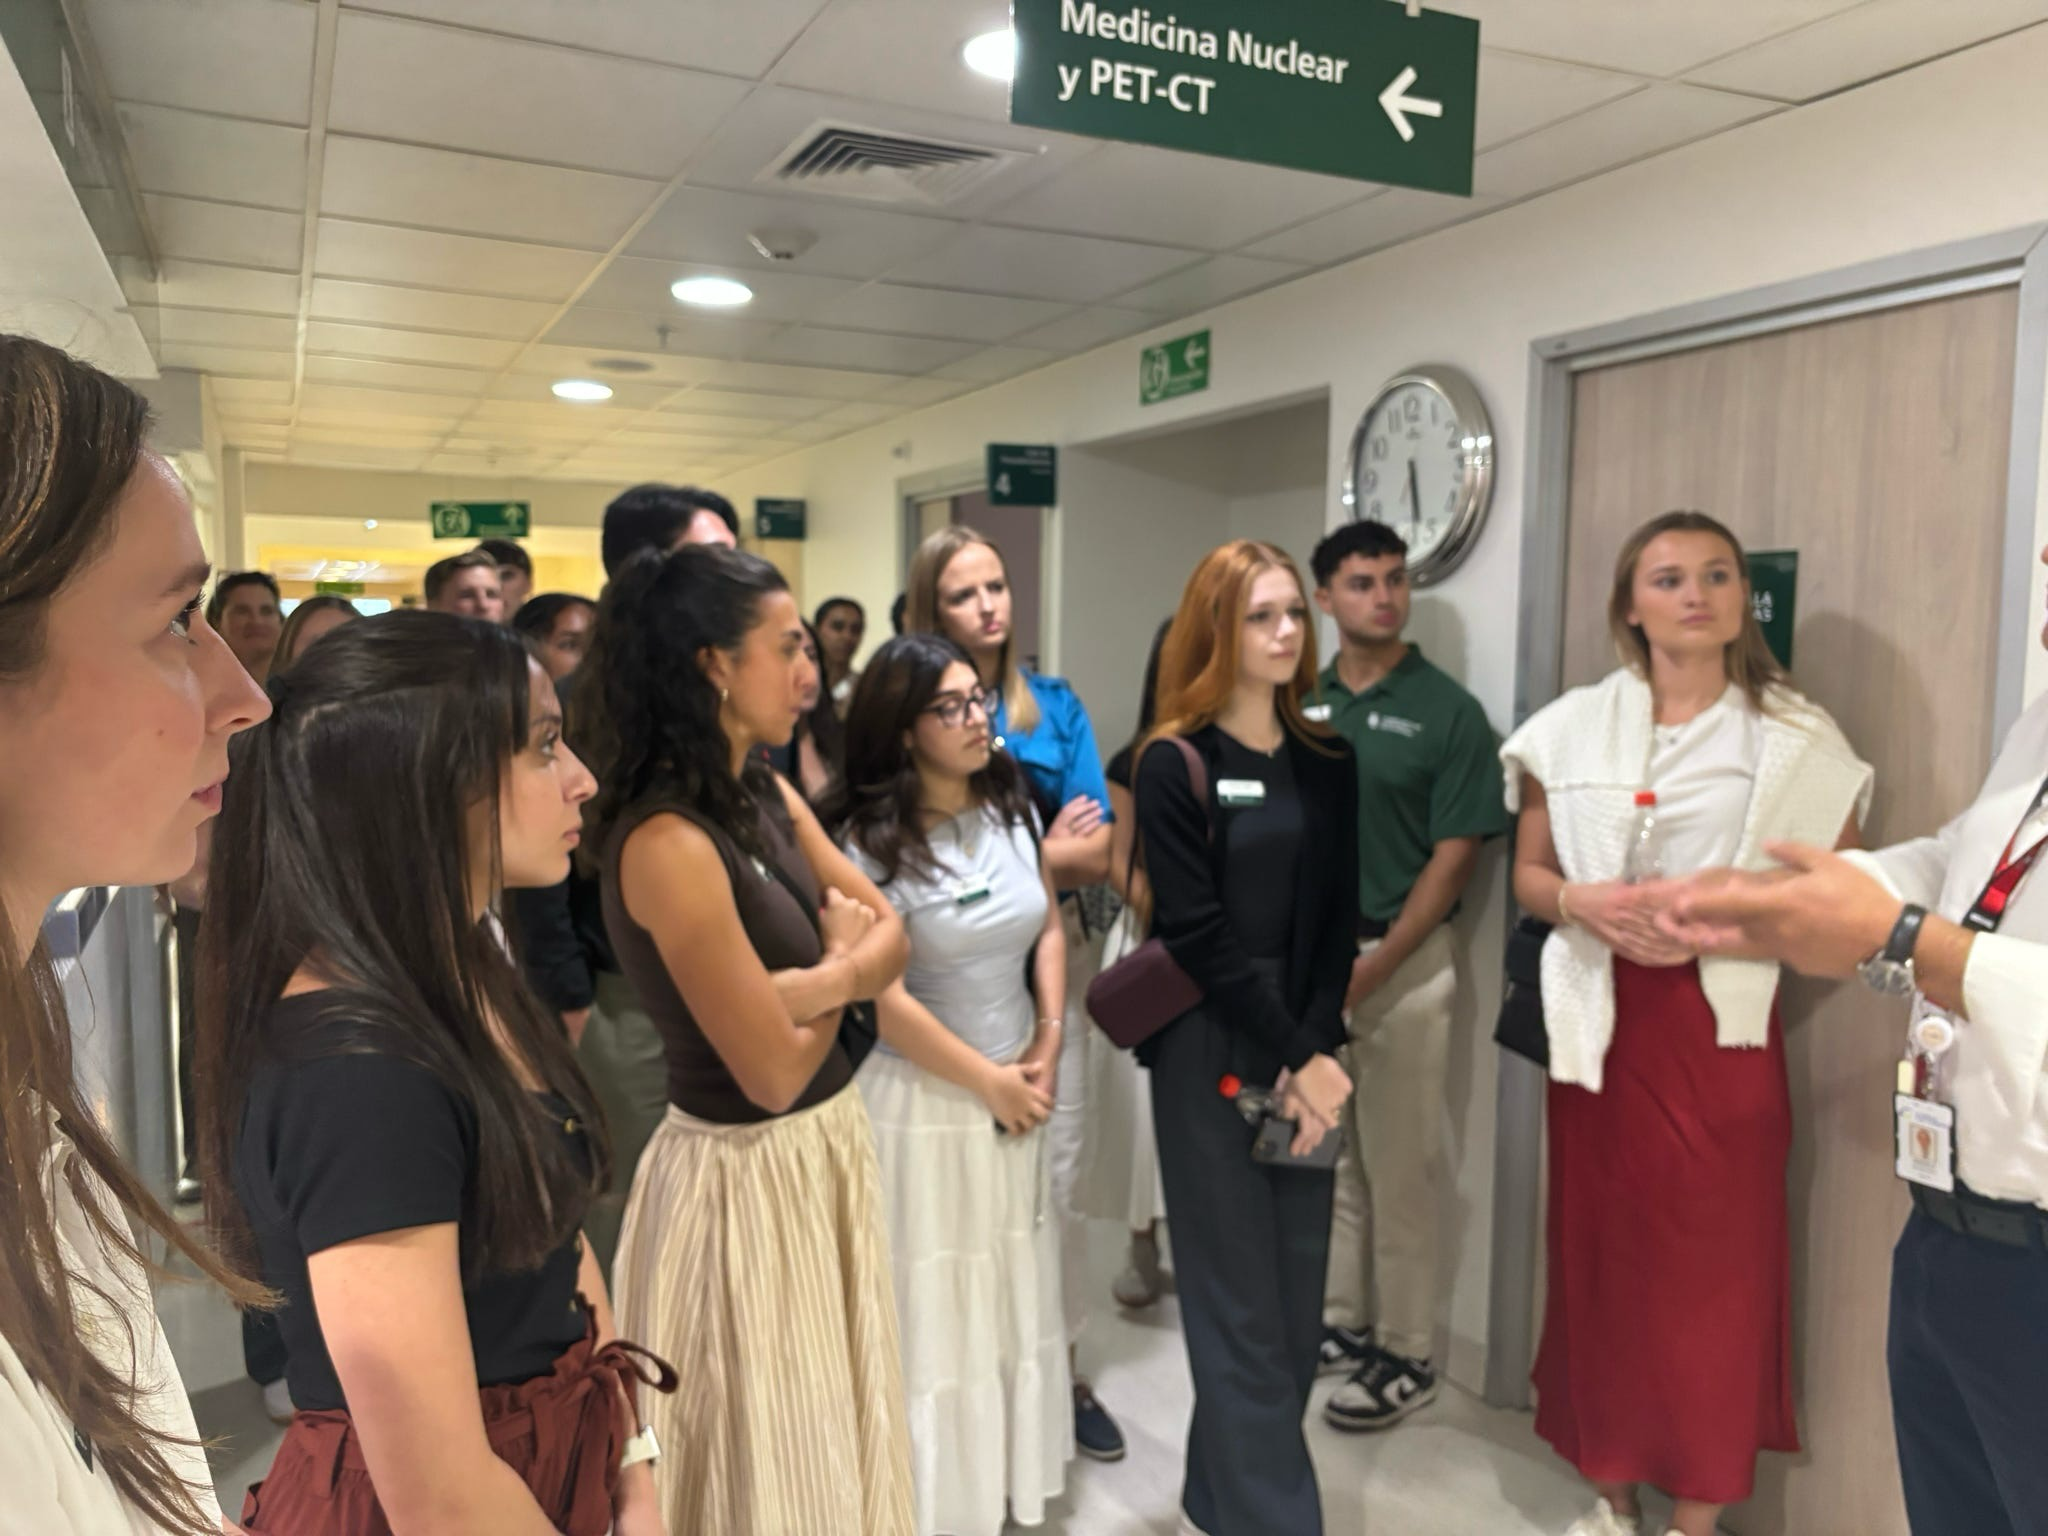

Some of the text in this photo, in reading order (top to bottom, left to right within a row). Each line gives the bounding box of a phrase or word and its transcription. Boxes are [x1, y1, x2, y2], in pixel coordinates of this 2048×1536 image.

[1061, 0, 1349, 84] Medicina Nuclear
[1058, 59, 1216, 114] y PET-CT
[1388, 409, 1402, 434] 11
[1404, 397, 1420, 423] 12
[1431, 401, 1439, 426] 1
[1445, 419, 1458, 448] 2
[1372, 436, 1387, 460] 10
[995, 473, 1011, 496] 4
[1364, 470, 1378, 493] 9
[1424, 517, 1436, 543] 5
